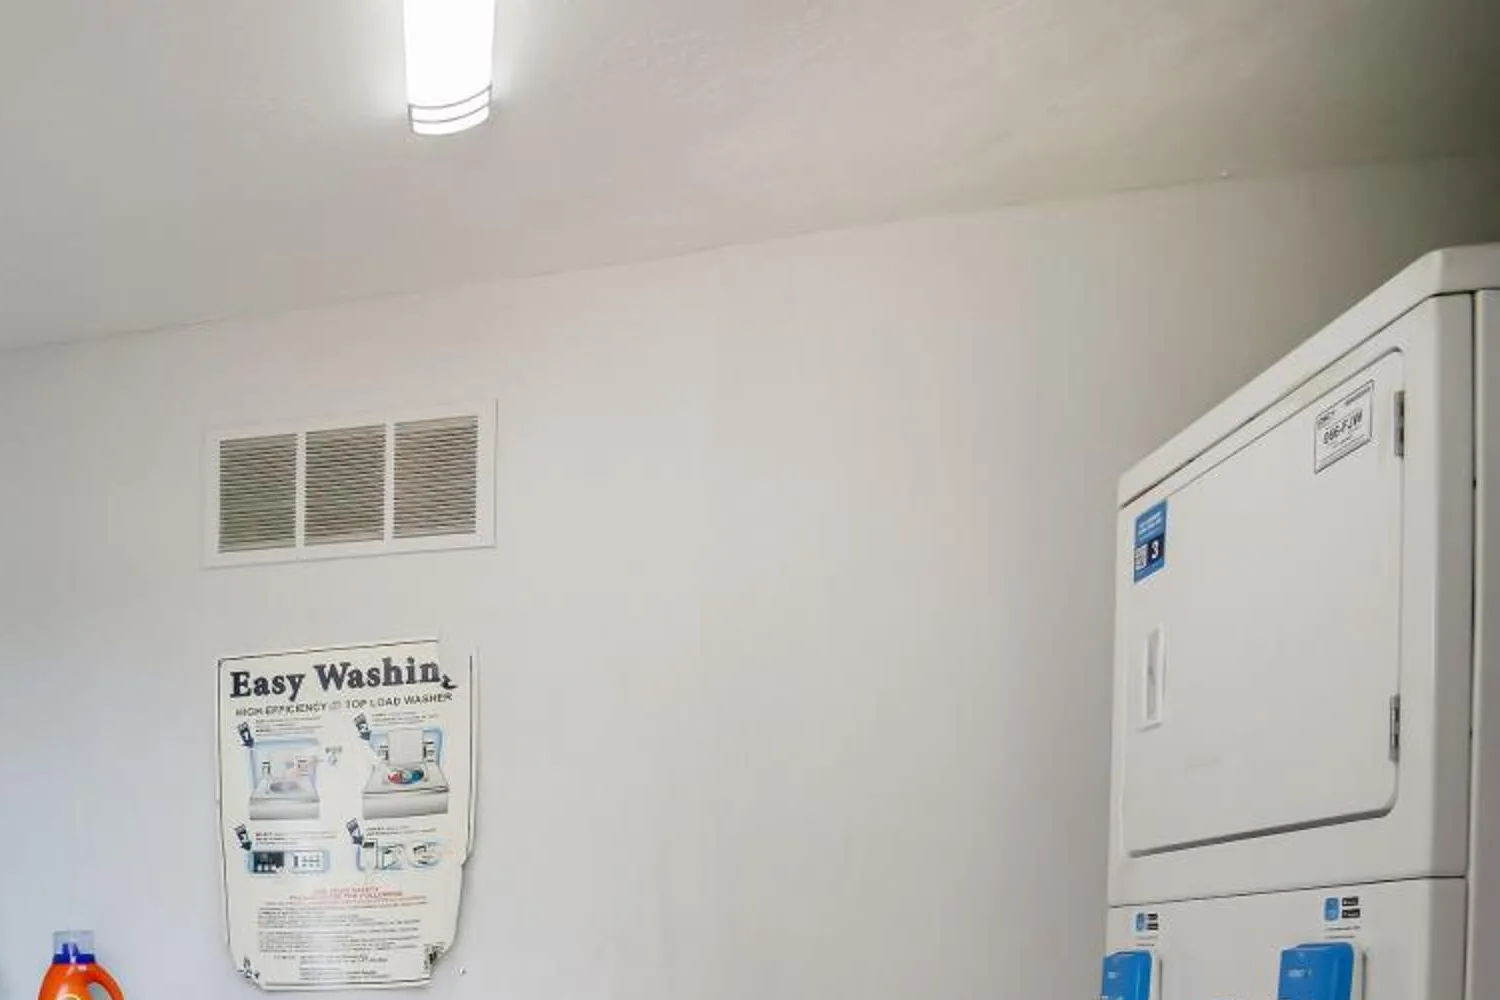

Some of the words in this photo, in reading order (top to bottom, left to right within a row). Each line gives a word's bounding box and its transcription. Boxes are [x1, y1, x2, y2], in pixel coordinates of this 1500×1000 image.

[1151, 540, 1159, 559] 3
[230, 671, 306, 701] Easy
[235, 705, 263, 718] HIGH
[264, 702, 326, 716] EFFICIENCY
[346, 698, 369, 710] TOP
[370, 697, 401, 709] LOAD
[403, 693, 454, 707] WASHER
